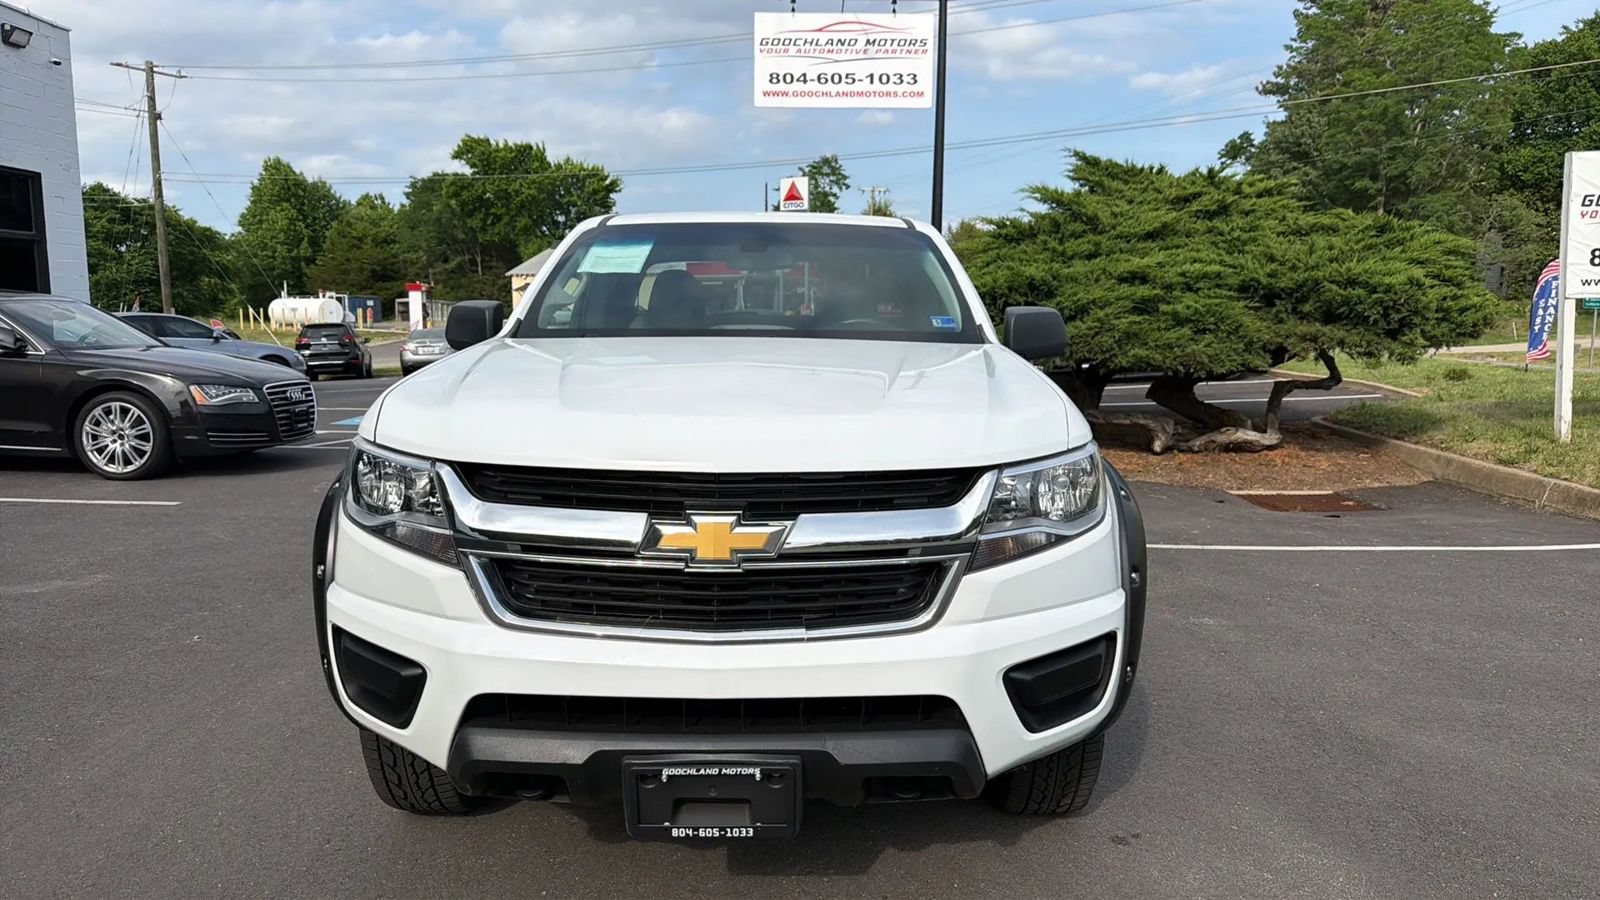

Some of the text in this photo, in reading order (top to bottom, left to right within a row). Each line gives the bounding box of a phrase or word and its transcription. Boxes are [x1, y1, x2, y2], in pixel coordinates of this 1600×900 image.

[759, 37, 928, 48] GOOCHLAND MOTORS
[768, 72, 918, 85] 804-605-1033
[762, 90, 924, 98] WWW.GOOCHLANDMOTORS.COM
[1533, 299, 1546, 333] EASY
[662, 767, 760, 776] GOOCHLAND MOTORS
[671, 827, 753, 837] 804-605-1033
